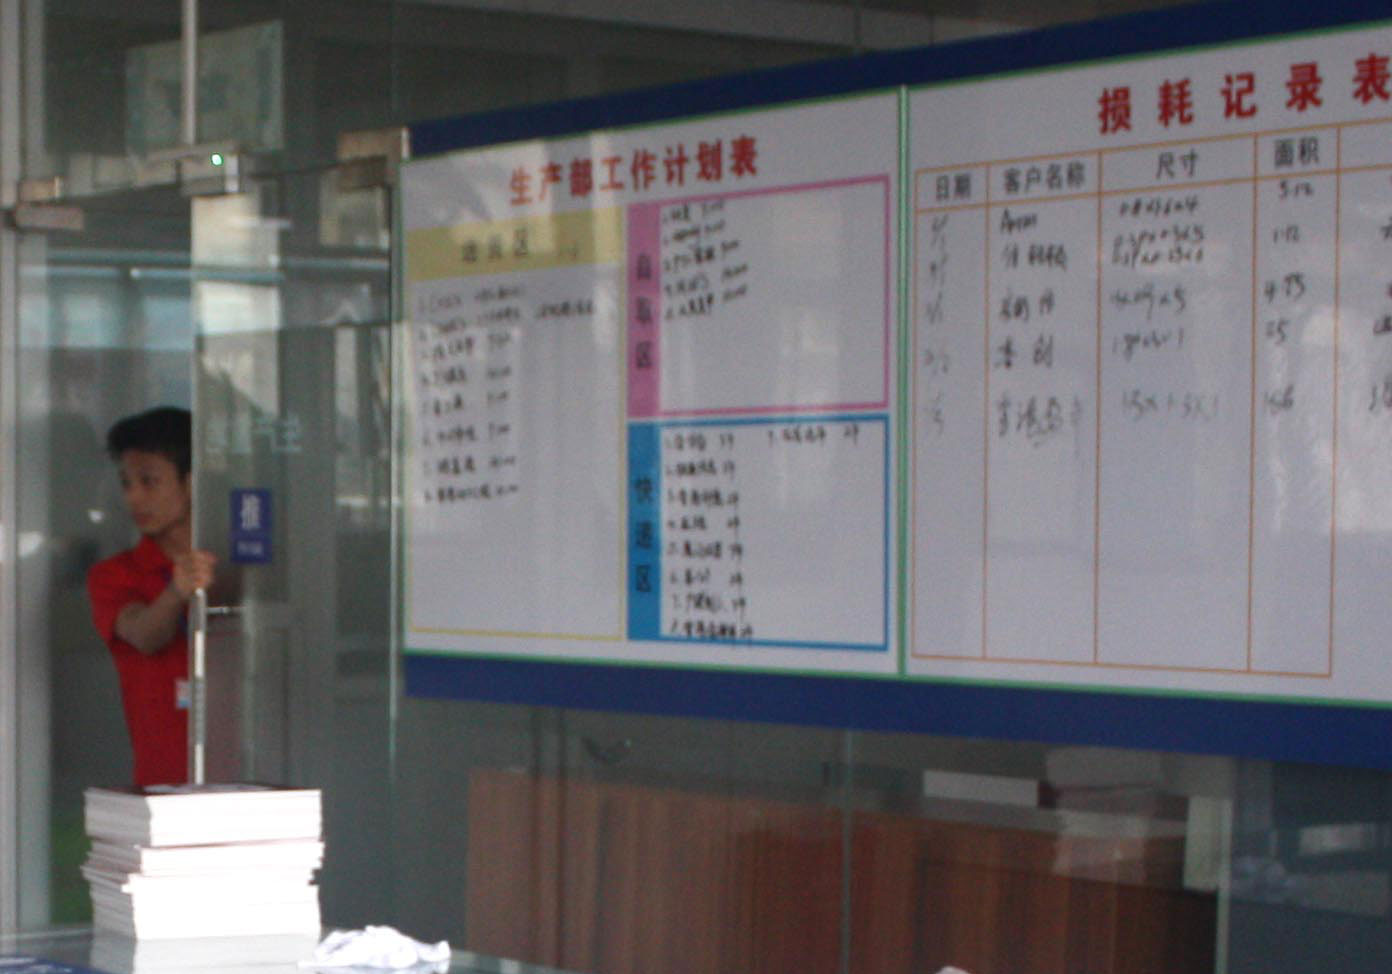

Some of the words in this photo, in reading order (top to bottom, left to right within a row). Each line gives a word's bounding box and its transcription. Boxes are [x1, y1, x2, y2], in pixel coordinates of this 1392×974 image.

[1097, 53, 1391, 136] 损耗记录表
[509, 135, 759, 206] 生产部工作计划表
[934, 173, 972, 201] 日期
[1003, 161, 1085, 194] 客户名称
[1156, 149, 1198, 180] 尺寸
[1273, 137, 1310, 168] 面积
